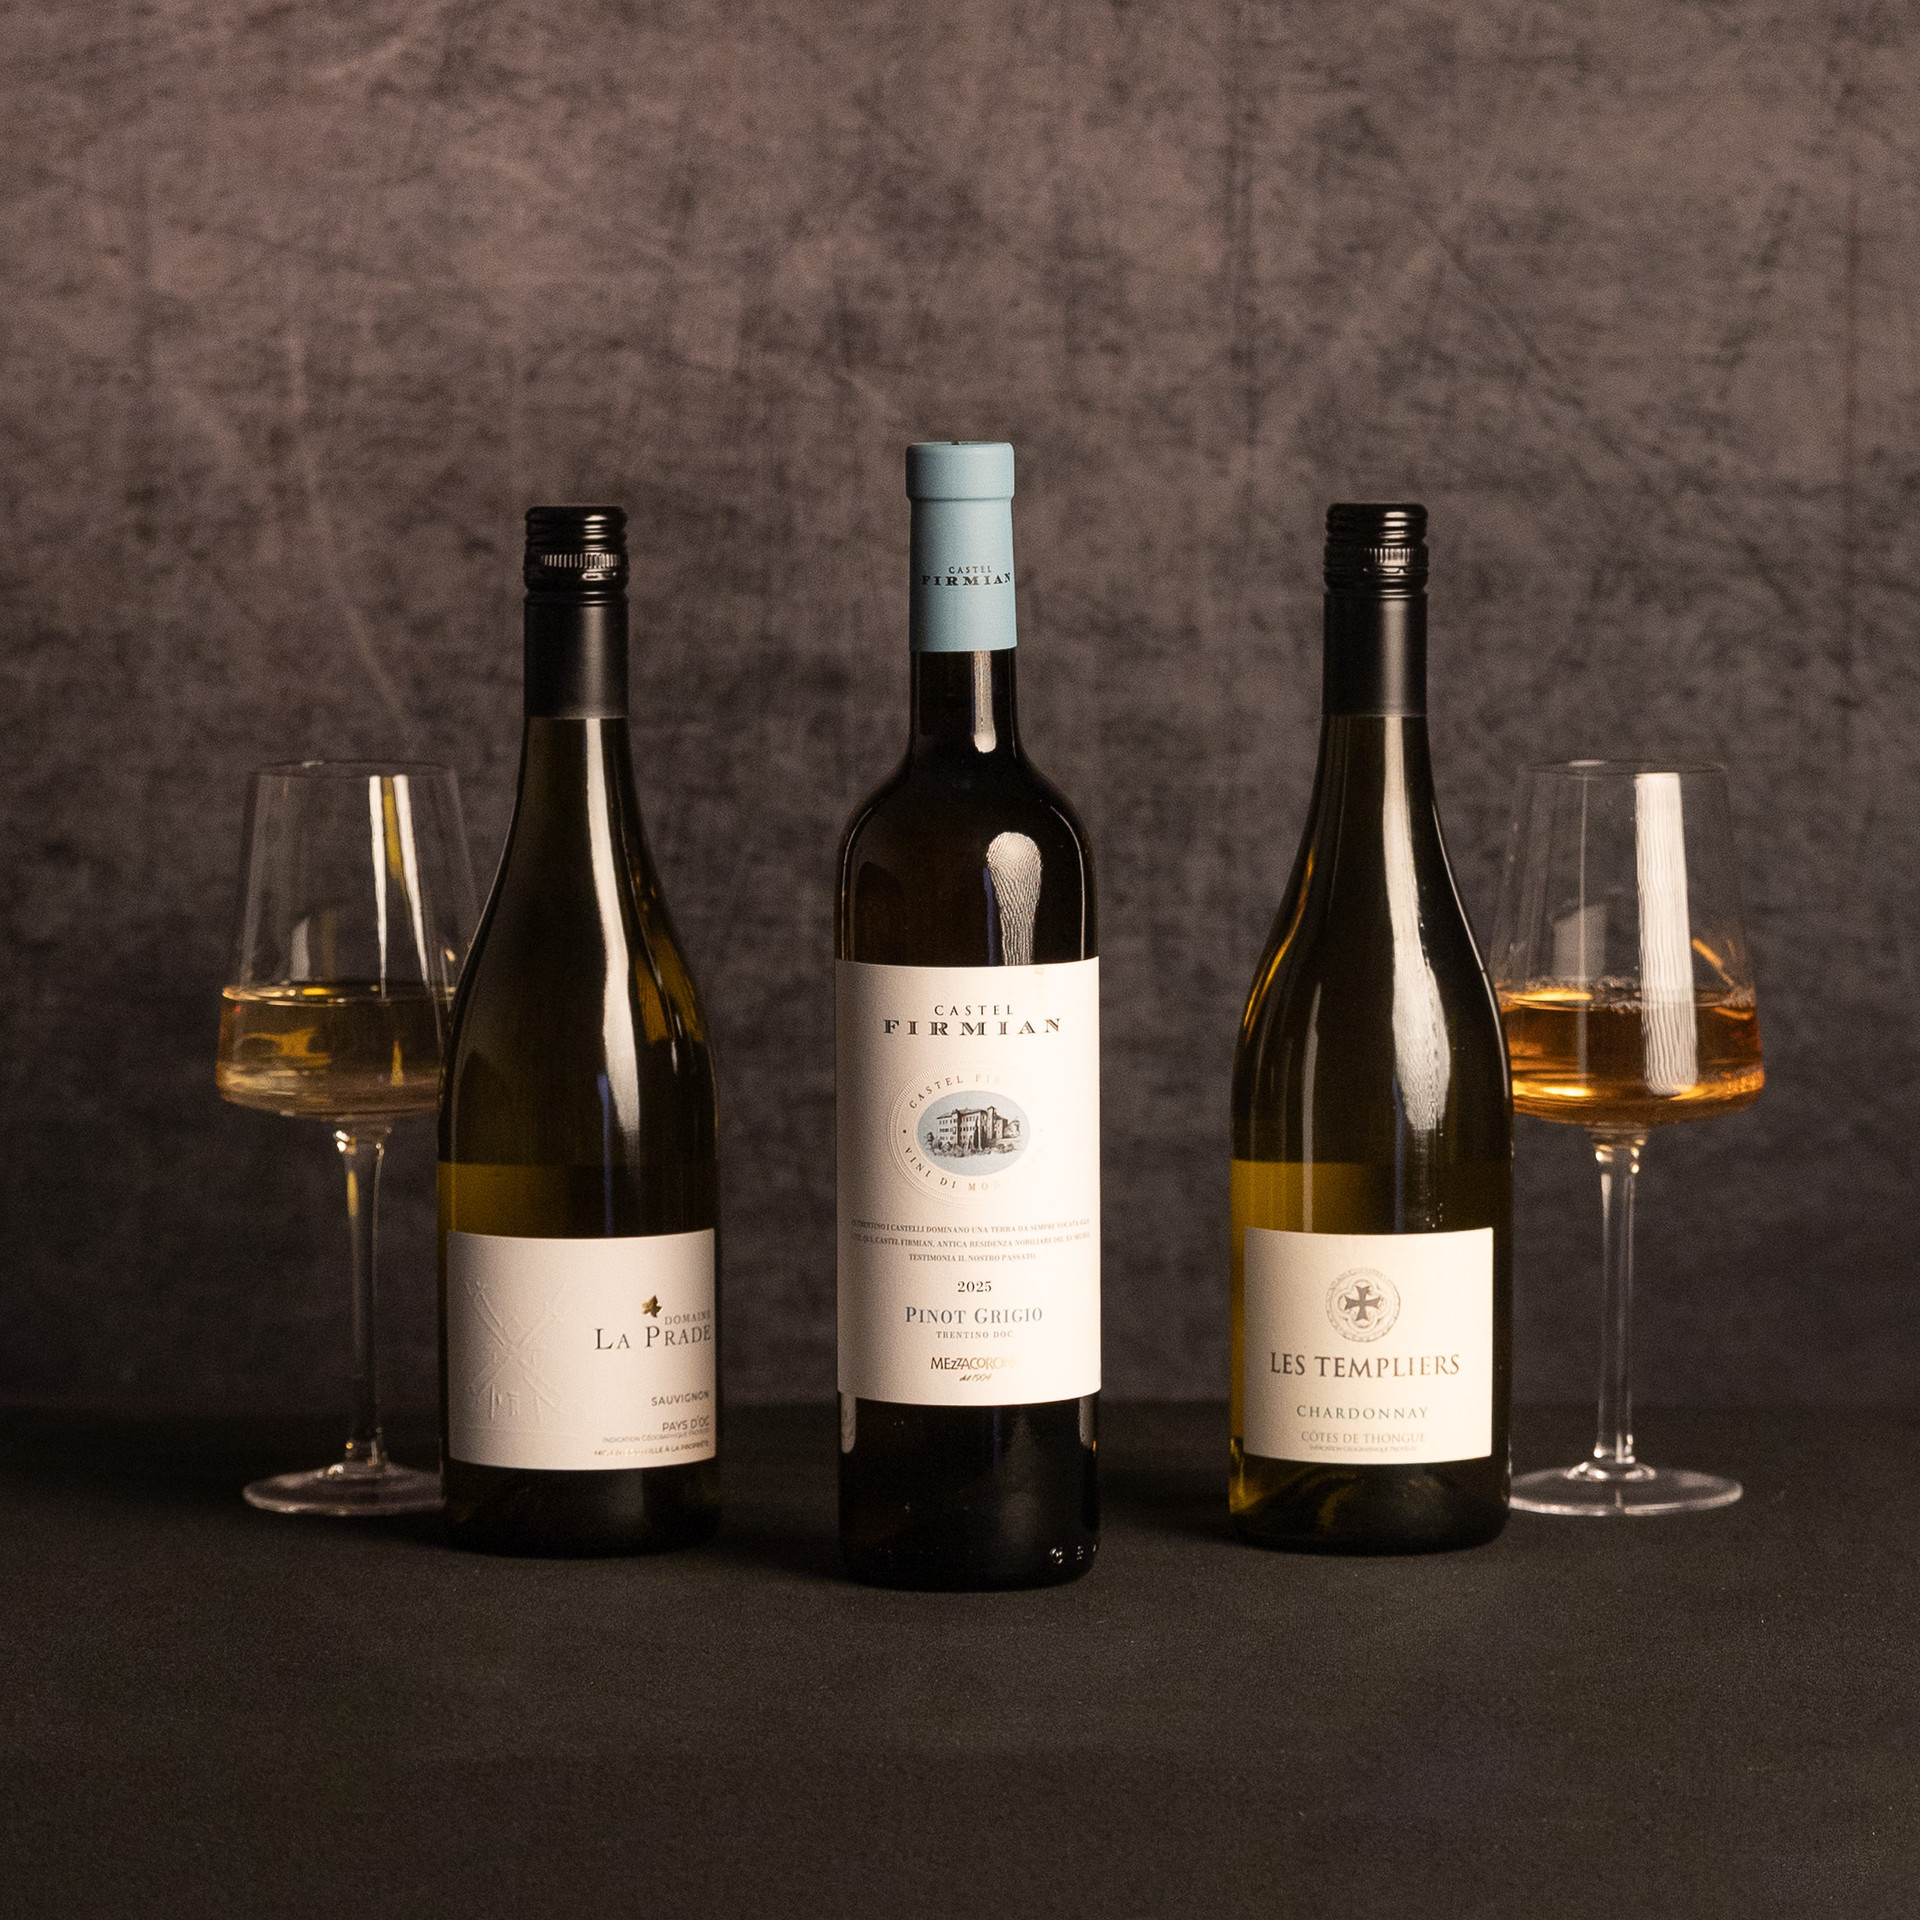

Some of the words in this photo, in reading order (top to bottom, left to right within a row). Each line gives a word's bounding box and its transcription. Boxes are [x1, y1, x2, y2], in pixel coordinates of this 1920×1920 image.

[948, 565, 992, 574] CASTEL
[921, 572, 1011, 587] FIRMIAN
[934, 1004, 1013, 1016] CASTEL
[883, 1017, 1061, 1036] FIRMIAN
[909, 1075, 964, 1110] CASTEL
[904, 1146, 932, 1178] VINI
[939, 1177, 957, 1189] DI
[891, 1224, 925, 1233] CASTELLI
[926, 1226, 970, 1234] DOMINANO
[971, 1226, 988, 1234] UNA
[937, 1240, 967, 1248] ANTICA
[969, 1239, 1013, 1248] RESIDENZA
[908, 1253, 956, 1262] TESTIMONIA
[957, 1254, 965, 1262] IL
[968, 1253, 1001, 1262] NOSTRO
[1001, 1252, 1036, 1261] PASSATO
[957, 1280, 993, 1293] 2025
[905, 1306, 967, 1324] PINOT
[974, 1307, 1043, 1324] GRIGIO
[644, 1325, 711, 1348] PRADE
[935, 1330, 989, 1339] TRENTINO
[993, 1330, 1014, 1339] DOC
[1270, 1351, 1306, 1376] LES
[1314, 1353, 1460, 1379] TEMPLIERS
[651, 1389, 710, 1407] SAUVIGNON
[1296, 1404, 1428, 1420] CHARDONNAY
[662, 1420, 688, 1432] PAYS
[1301, 1430, 1338, 1443] CÔTES
[1343, 1432, 1358, 1444] DE
[1363, 1432, 1425, 1444] THONGUE
